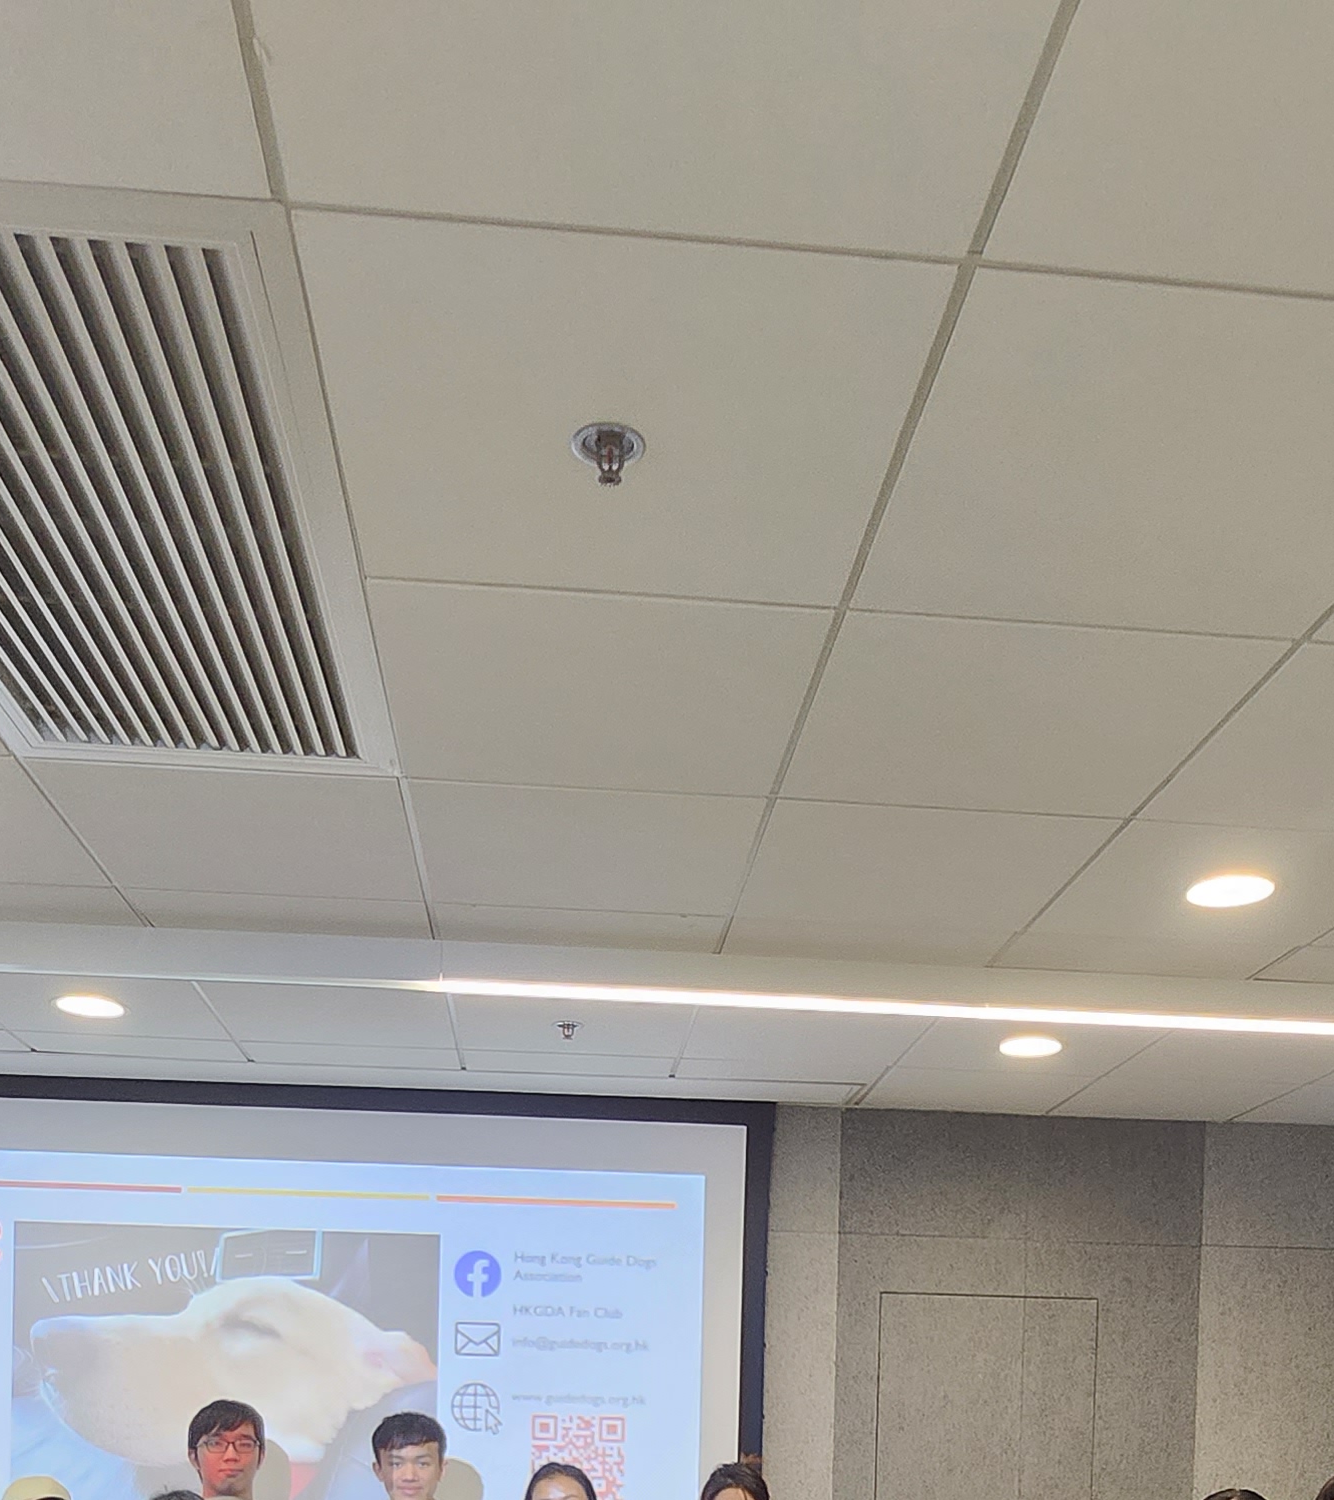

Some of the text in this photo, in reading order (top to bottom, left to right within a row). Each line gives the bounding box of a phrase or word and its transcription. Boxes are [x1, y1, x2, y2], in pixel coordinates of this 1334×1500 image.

[513, 1251, 547, 1267] Hong
[550, 1252, 583, 1269] Kong
[568, 1305, 591, 1319] Fan
[593, 1307, 623, 1319] Club
